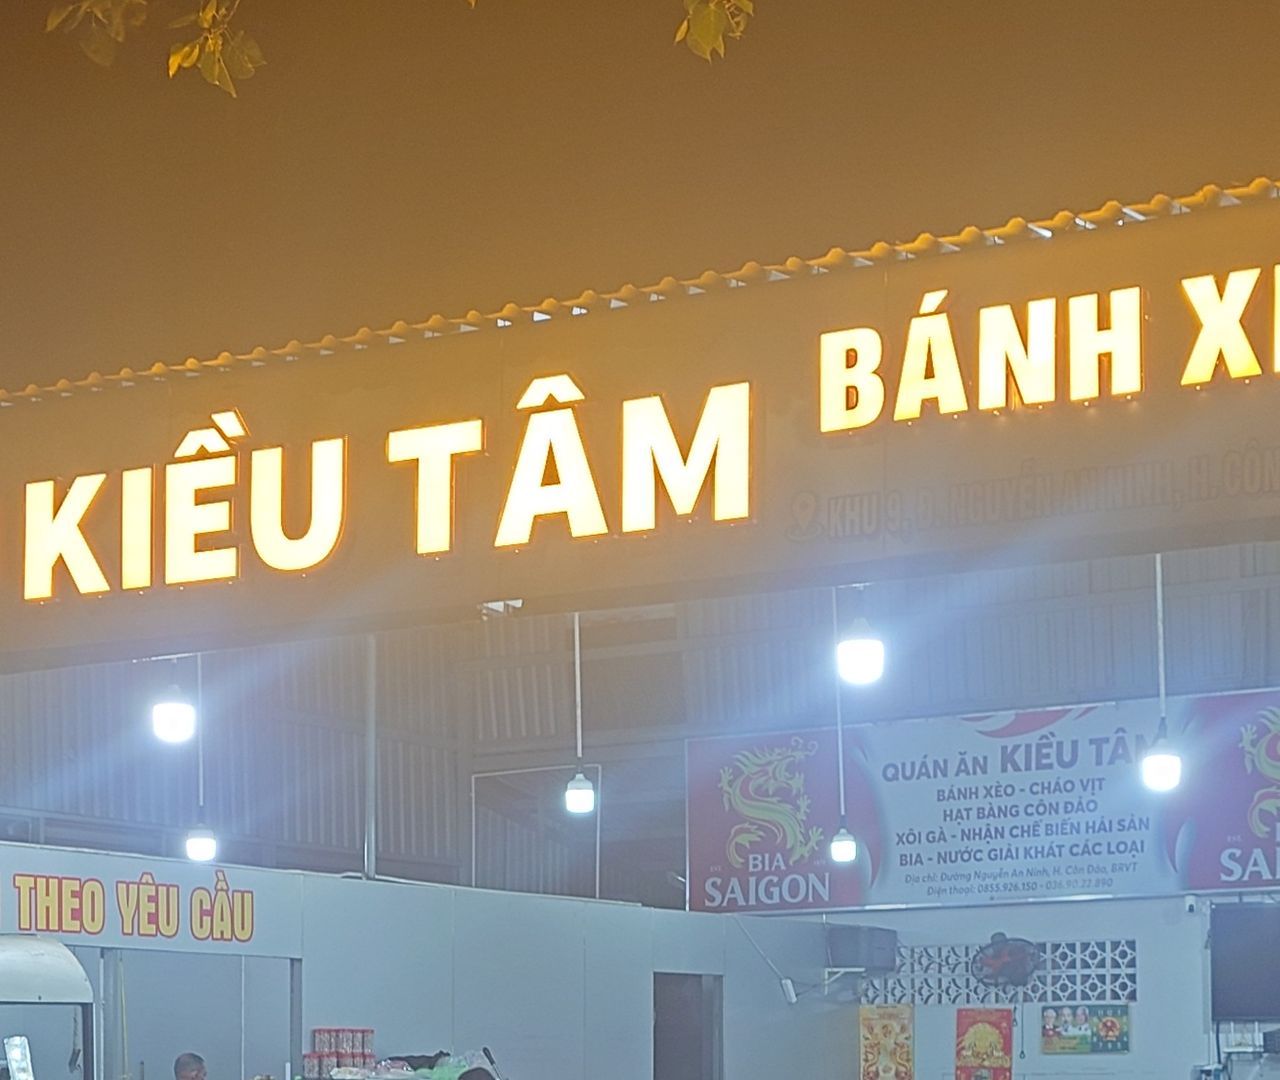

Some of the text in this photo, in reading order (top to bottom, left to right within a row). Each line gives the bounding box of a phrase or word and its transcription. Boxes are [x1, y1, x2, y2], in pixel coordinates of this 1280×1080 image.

[819, 286, 1142, 433] BÁNH
[23, 411, 344, 601] KIỀU
[387, 374, 751, 555] TÂM
[881, 755, 949, 783] QUÁN
[953, 751, 989, 778] ĂN
[999, 731, 1080, 774] KIỀU
[936, 784, 979, 802] BÁNH
[983, 780, 1016, 799] XÈO
[1029, 776, 1076, 796] CHÁO
[1080, 777, 1106, 797] VỊT
[943, 796, 1098, 826] HẠT BÀNG CÔN ĐẢO
[896, 828, 922, 846] XÔI
[926, 826, 948, 844] GÀ
[960, 823, 1005, 845] NHẬN
[1009, 818, 1042, 839] CHẾ
[1044, 817, 1081, 837] BIẾN
[1085, 815, 1113, 835] HẢI
[1117, 813, 1150, 833] SẢN
[748, 852, 787, 873] BIA
[899, 853, 924, 867] BIA
[937, 846, 984, 865] NƯỚC
[988, 843, 1019, 861] GIẢI
[1023, 841, 1066, 860] KHÁT
[1069, 838, 1103, 857] CÁC
[1107, 840, 1145, 859] LOẠI
[14, 873, 106, 935] THEO
[116, 871, 180, 939] YÊU
[190, 869, 255, 943] CẦU
[704, 872, 830, 908] SAIGON
